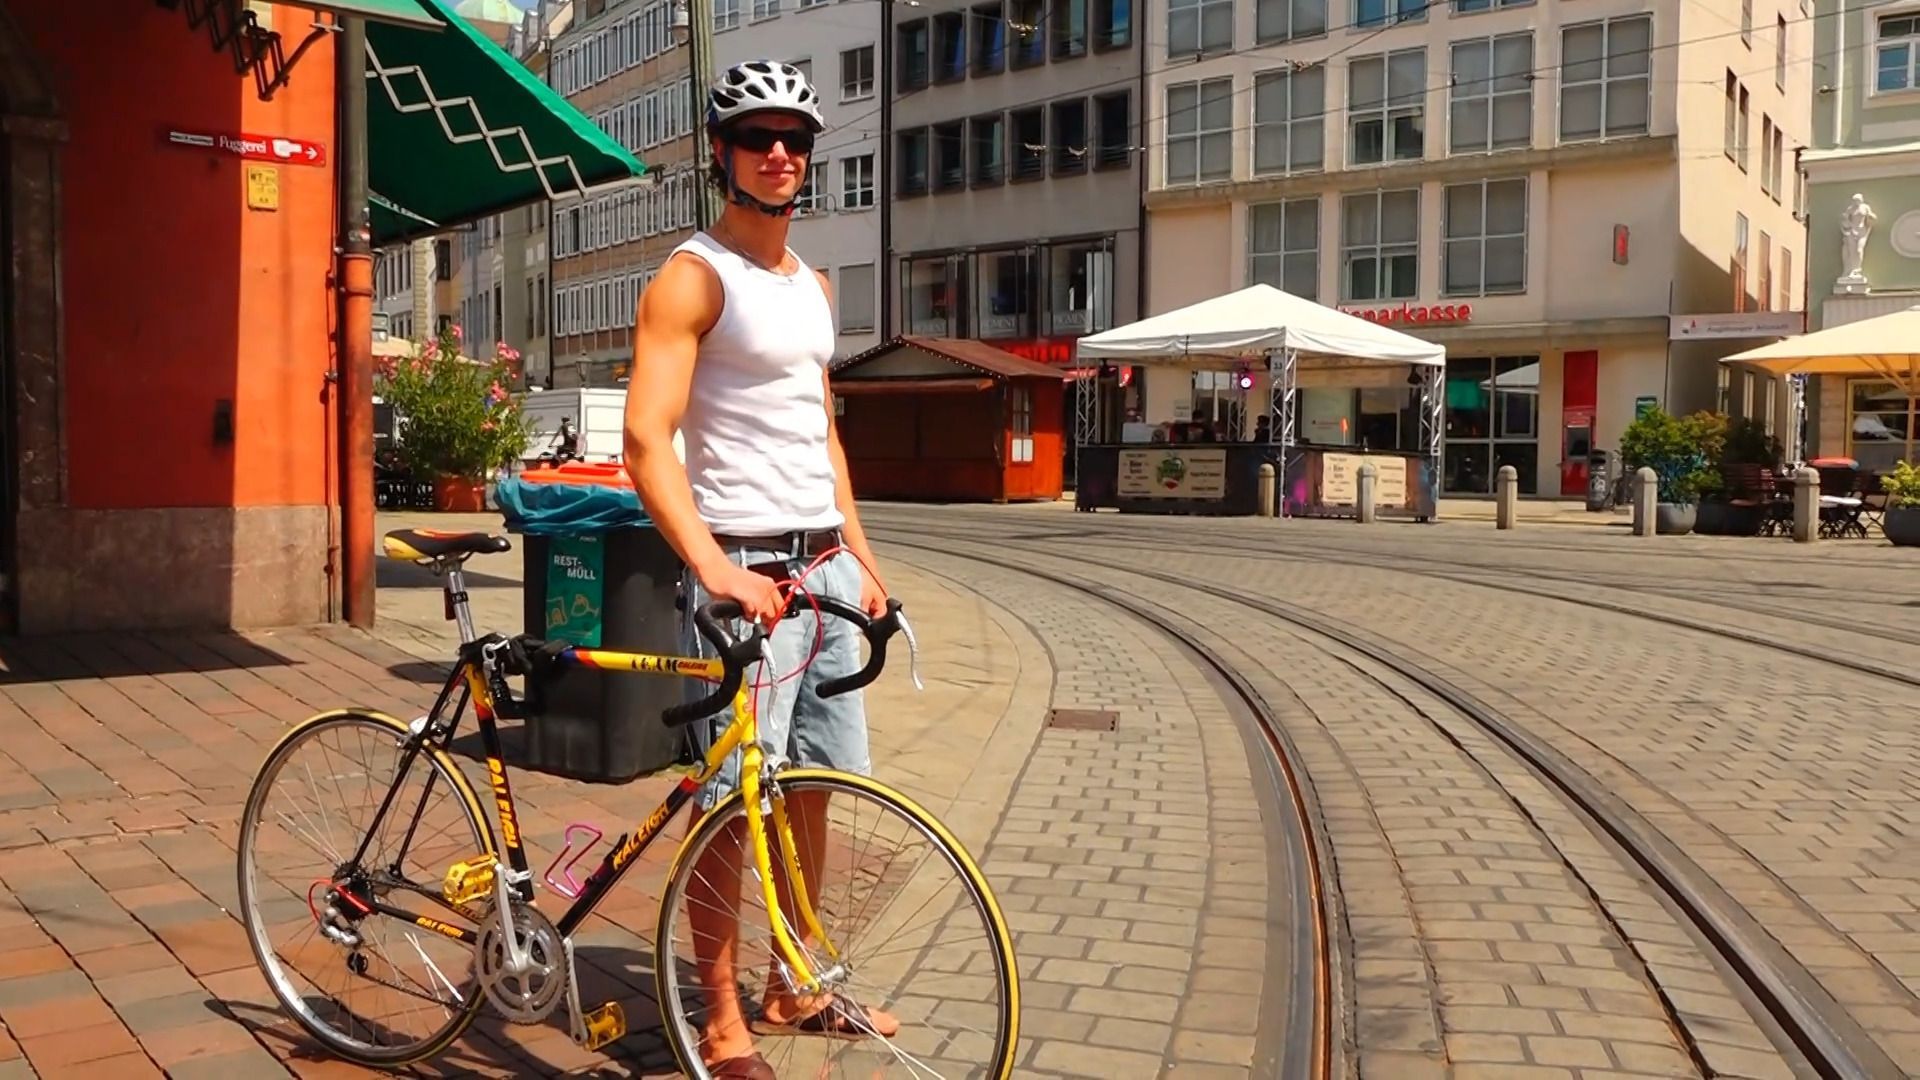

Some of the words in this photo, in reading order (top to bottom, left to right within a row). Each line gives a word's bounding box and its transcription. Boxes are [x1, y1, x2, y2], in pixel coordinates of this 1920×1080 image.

[220, 135, 266, 154] Fuggerei
[1336, 302, 1472, 325] sparkasse
[553, 555, 582, 567] REST-
[567, 566, 596, 580] MÜLL
[486, 757, 519, 848] RALEIGH
[613, 802, 670, 871] RALEIGH
